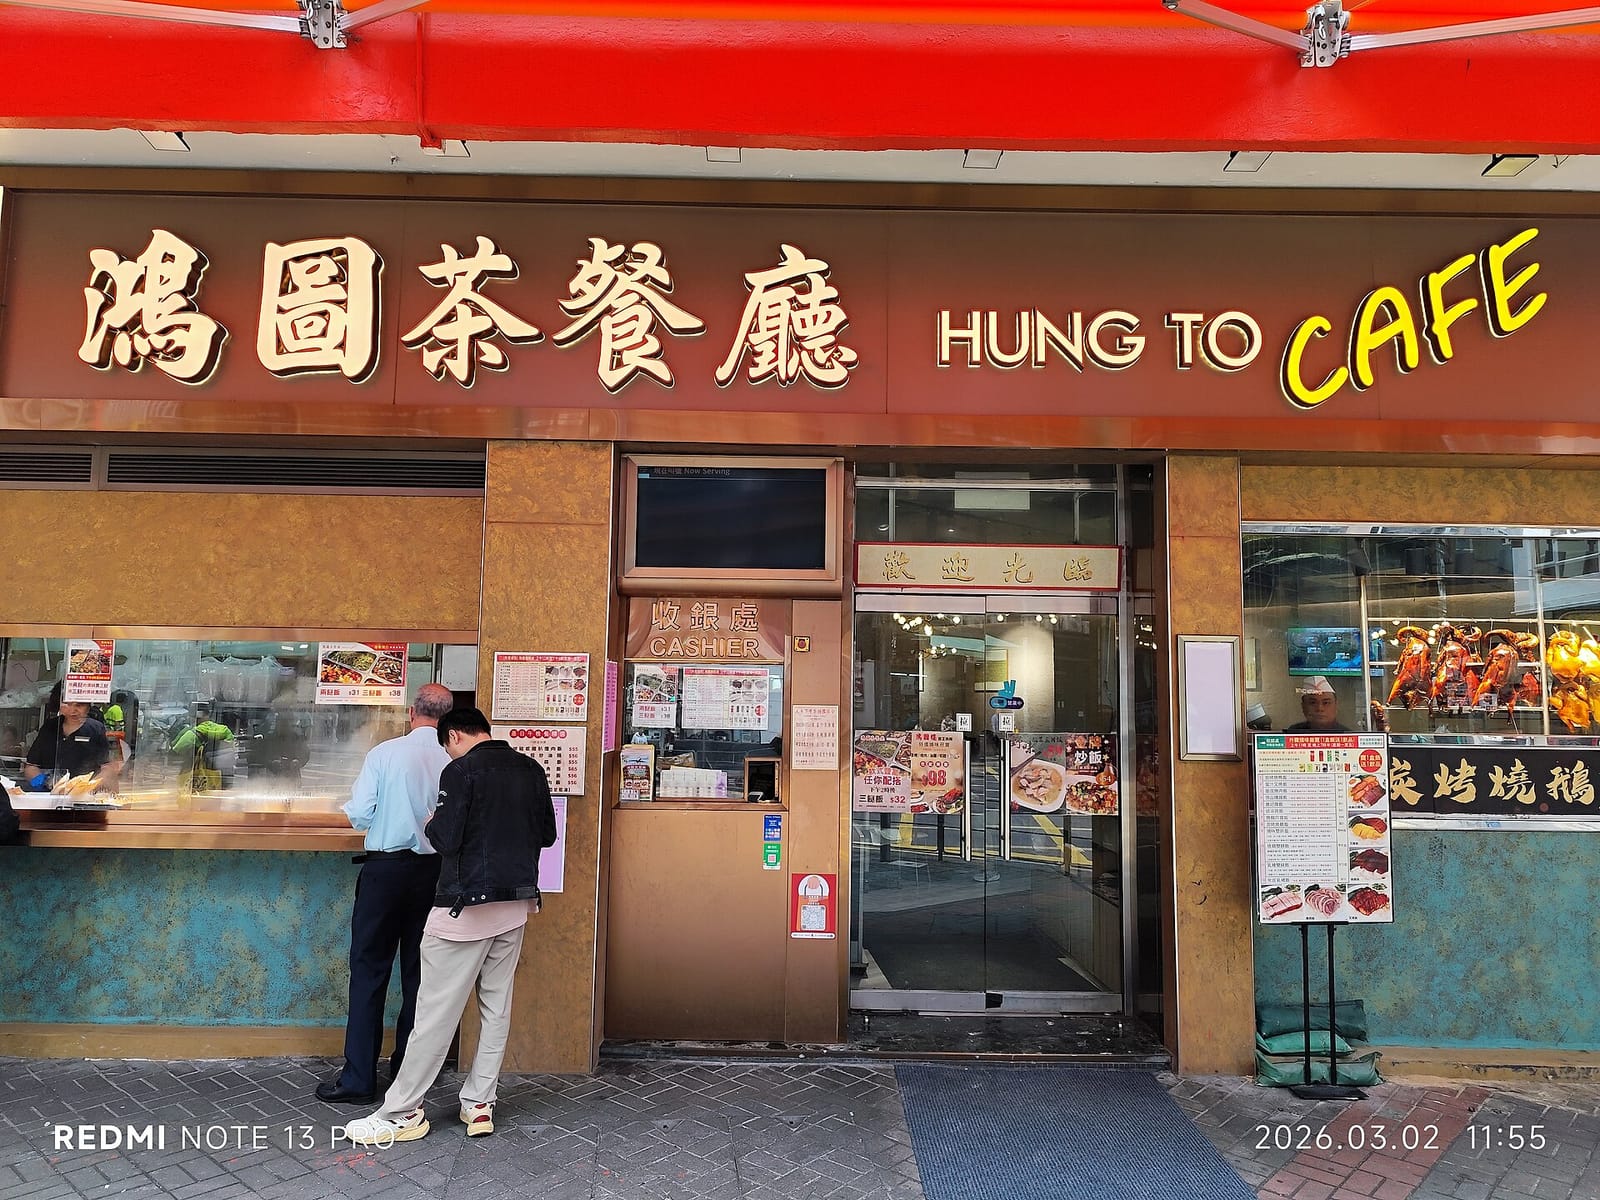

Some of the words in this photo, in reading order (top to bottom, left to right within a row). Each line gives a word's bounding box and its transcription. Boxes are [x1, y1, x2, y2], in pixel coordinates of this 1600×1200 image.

[78, 229, 859, 394] 鴻圖茶餐廳
[937, 309, 1145, 373] HUNG
[1164, 309, 1263, 372] TO
[1279, 227, 1549, 410] CAFE
[684, 467, 701, 475] Now
[702, 467, 731, 476] Serving
[882, 550, 1094, 584] 歡迎光臨
[651, 600, 760, 633] 收銀處
[650, 636, 761, 658] CASHIER
[1074, 750, 1103, 764] 炒飯
[864, 776, 902, 786] 任你配搭
[921, 770, 947, 786] $98
[1390, 756, 1596, 807] 炭烤燒鵝
